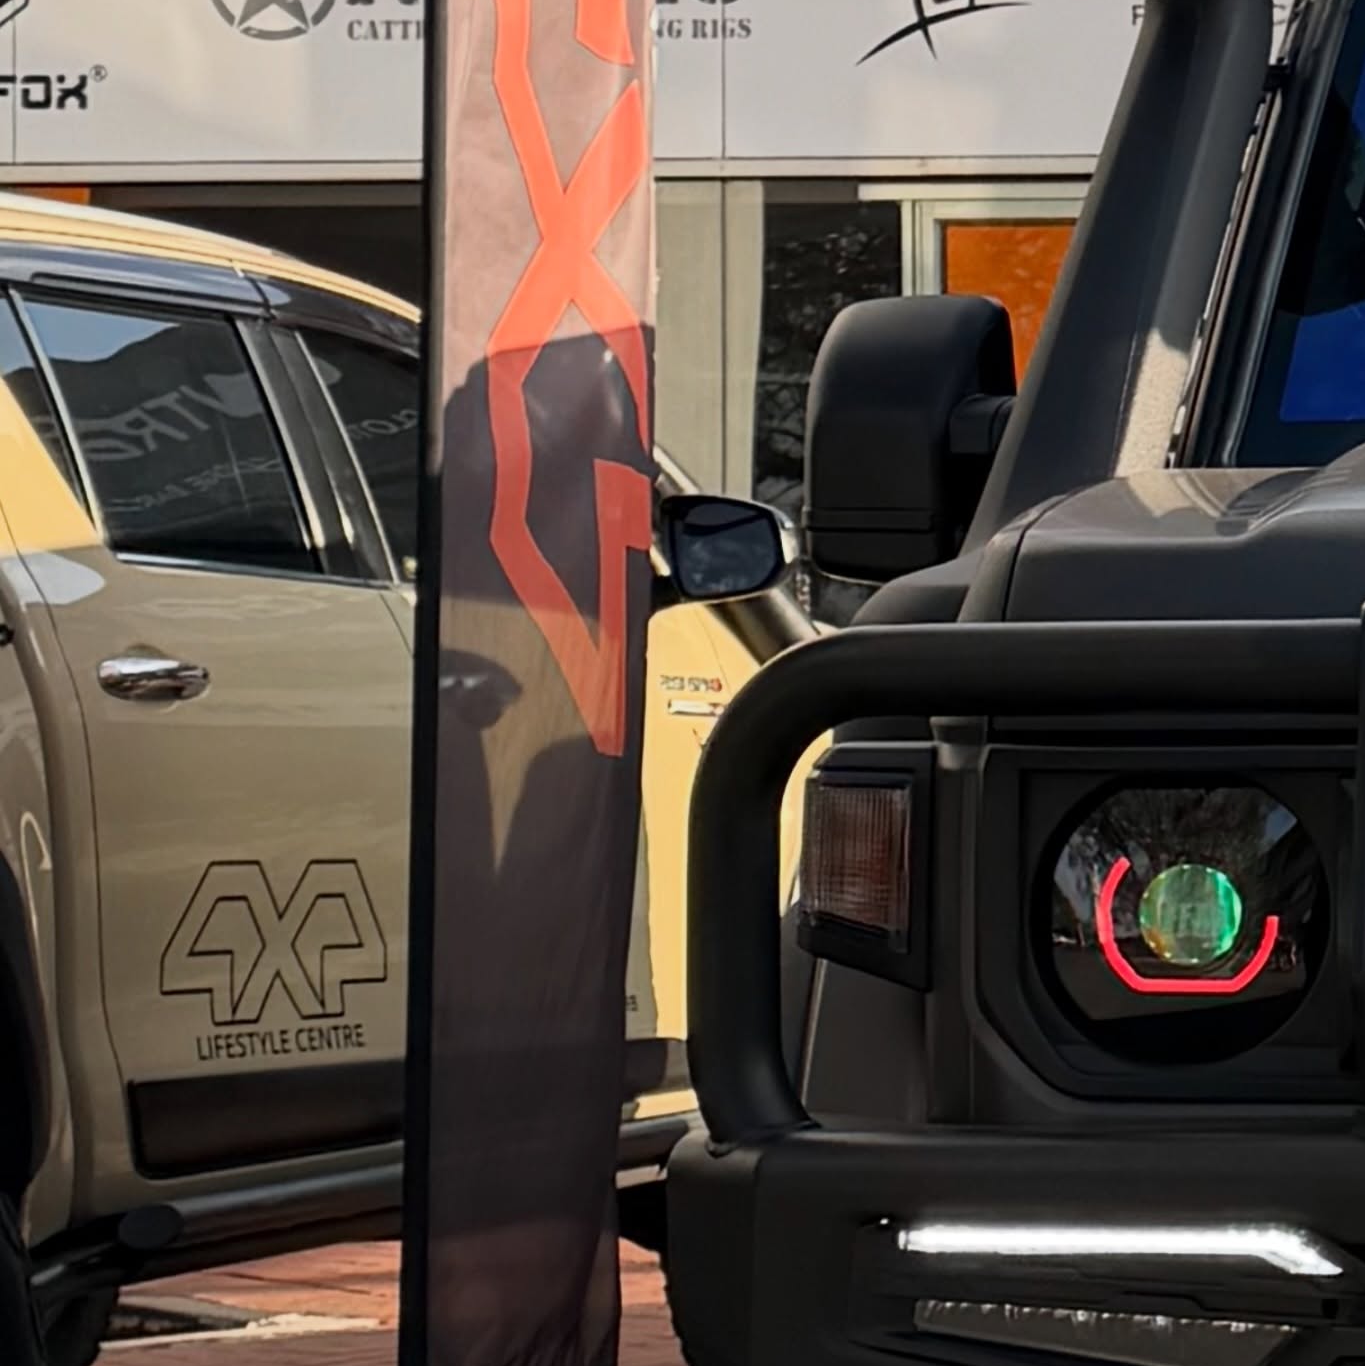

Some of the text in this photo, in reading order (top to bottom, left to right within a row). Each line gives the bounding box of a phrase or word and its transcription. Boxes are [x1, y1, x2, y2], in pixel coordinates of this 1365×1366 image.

[692, 17, 752, 40] RIGS
[196, 1022, 366, 1062] LIFESTYLE CENTRE
